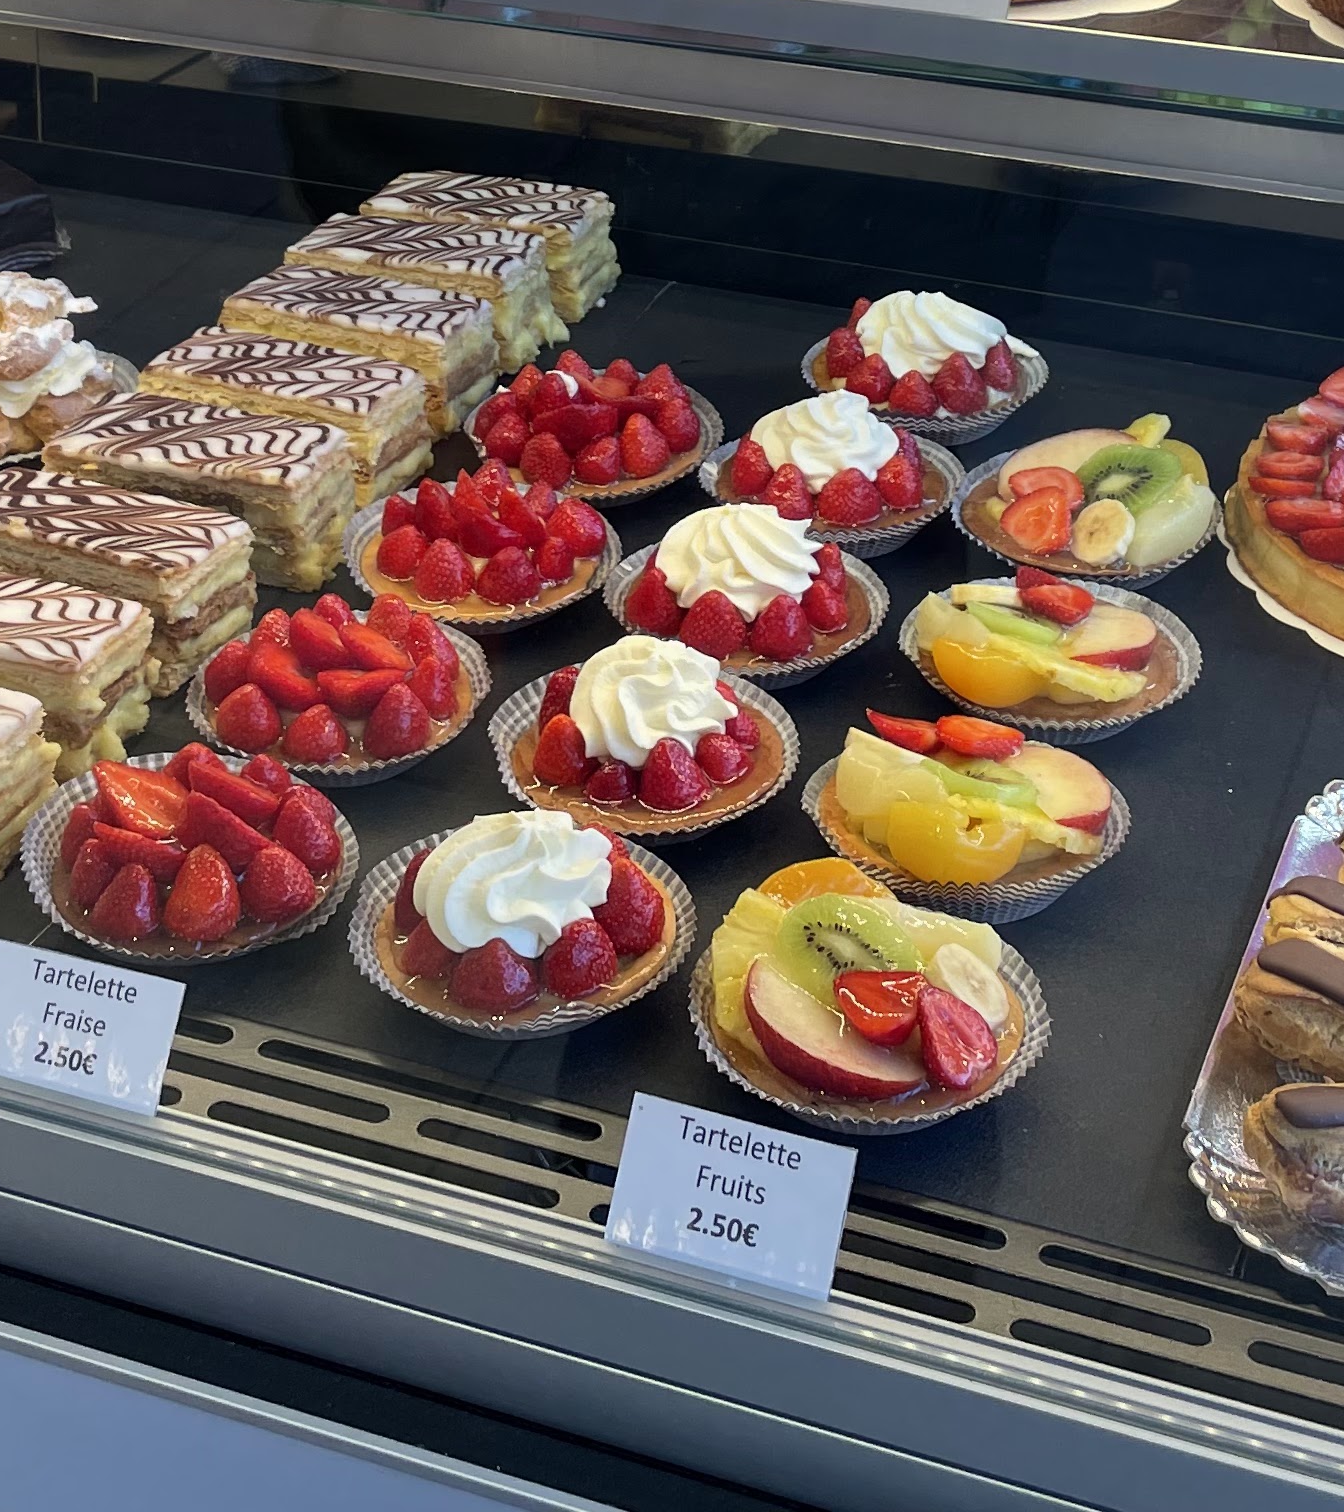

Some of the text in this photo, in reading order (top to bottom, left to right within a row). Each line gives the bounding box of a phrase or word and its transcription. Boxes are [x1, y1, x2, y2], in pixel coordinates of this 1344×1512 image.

[33, 958, 138, 1004] Tartelette
[42, 1002, 107, 1037] Fraise
[34, 1041, 98, 1076] 2.50€
[680, 1115, 802, 1171] Tartelette
[696, 1165, 766, 1206] Fruits
[686, 1207, 760, 1248] 2.50€
